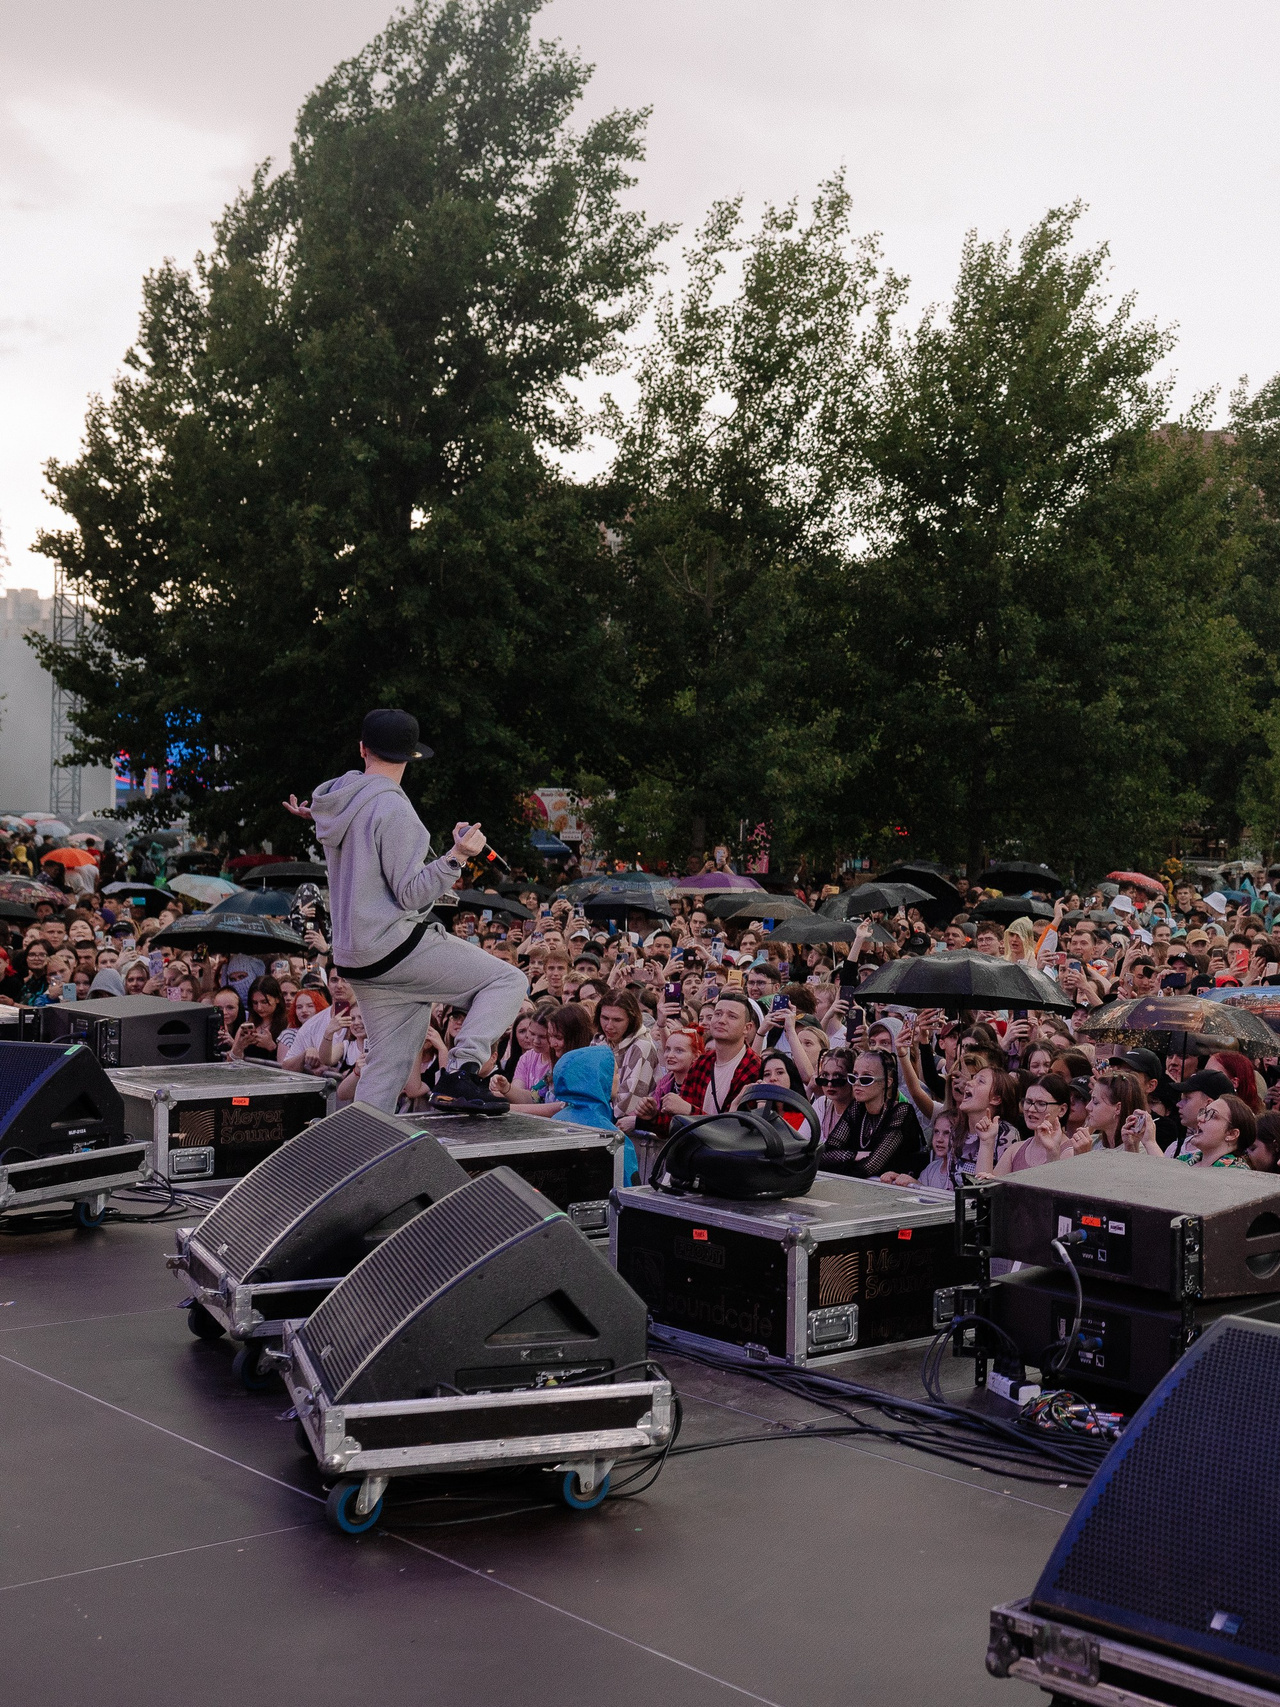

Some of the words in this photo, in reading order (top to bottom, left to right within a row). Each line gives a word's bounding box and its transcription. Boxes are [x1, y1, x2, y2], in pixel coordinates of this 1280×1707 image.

[221, 1109, 284, 1128] Meyer
[220, 1124, 284, 1144] Sound
[866, 1247, 933, 1274] Meyer
[865, 1265, 935, 1300] Sound
